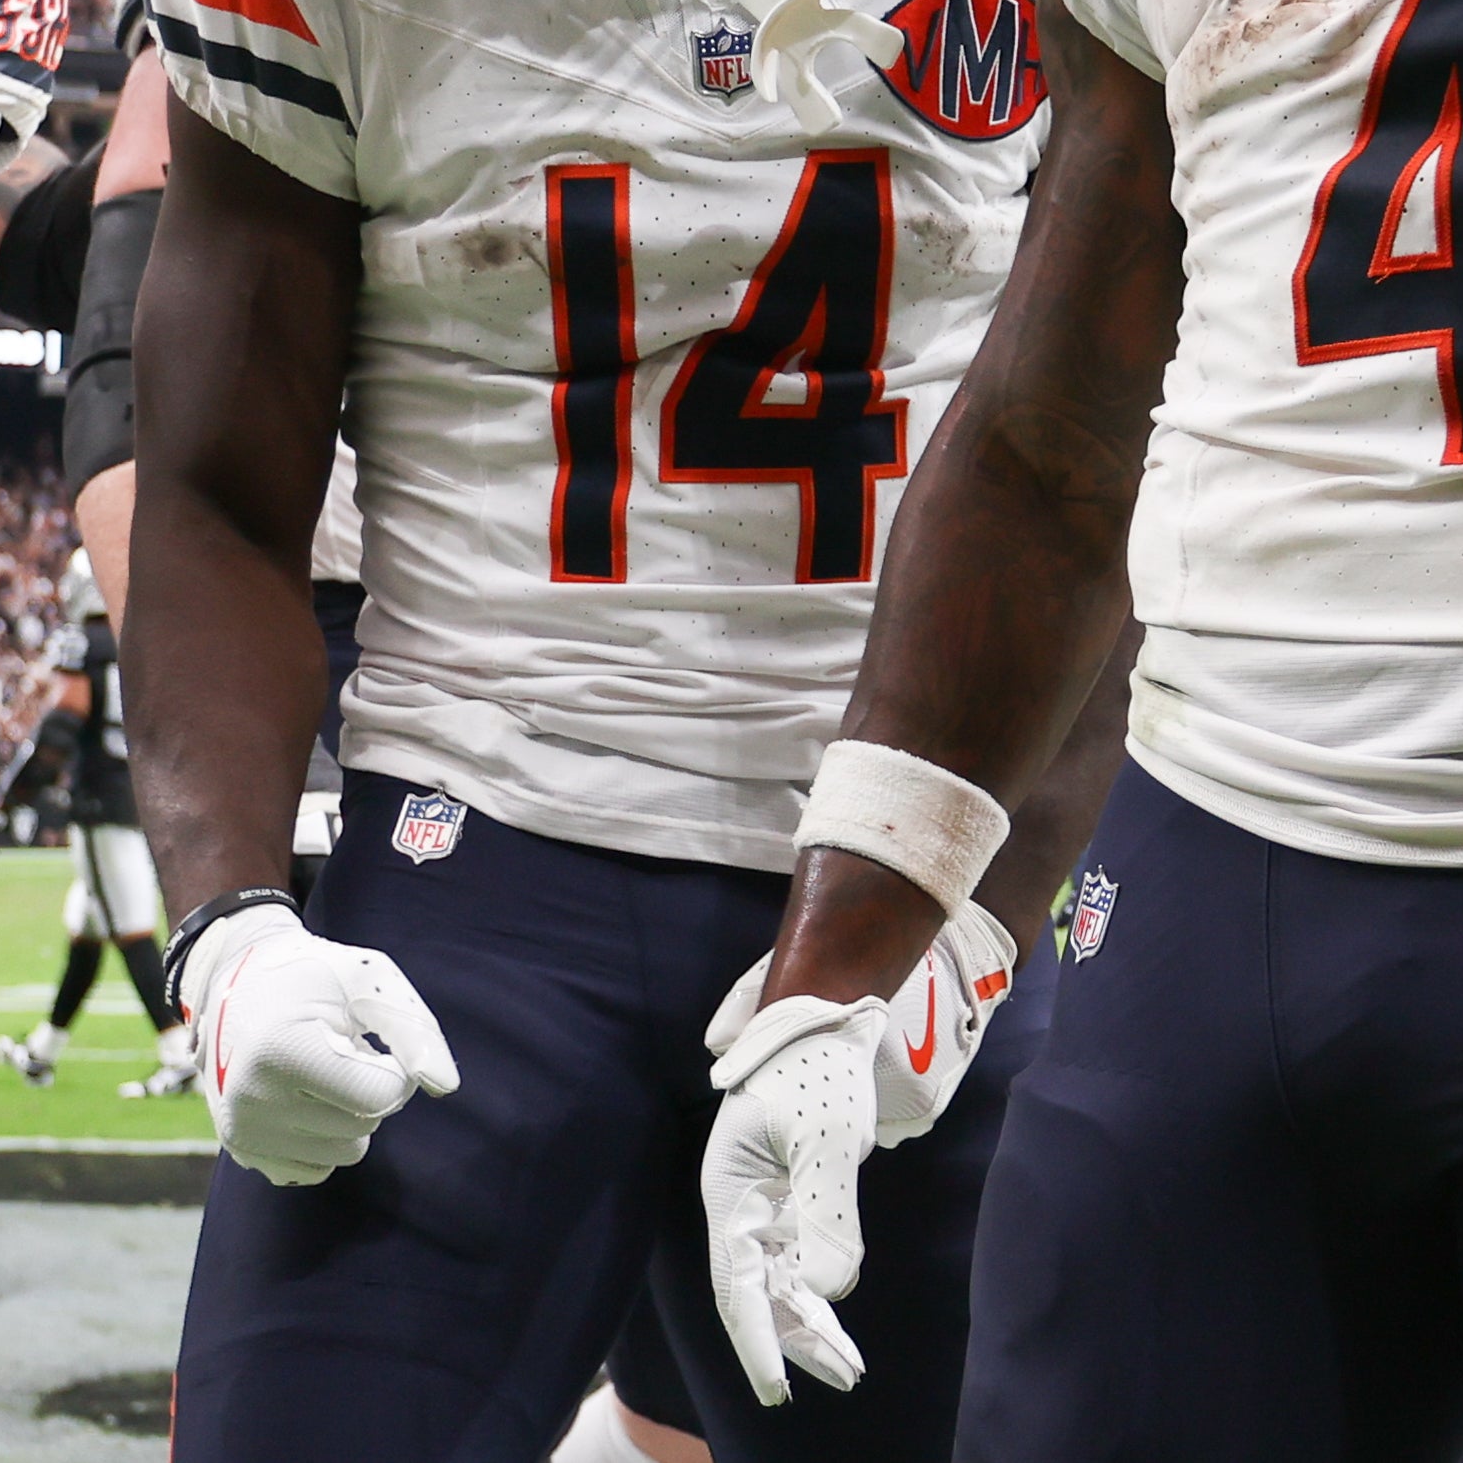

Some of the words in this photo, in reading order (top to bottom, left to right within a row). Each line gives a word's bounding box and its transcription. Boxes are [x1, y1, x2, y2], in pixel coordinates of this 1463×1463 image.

[703, 56, 751, 89] NFL
[545, 147, 909, 584] 14
[402, 820, 446, 850] NFL
[1075, 907, 1100, 946] NFL
